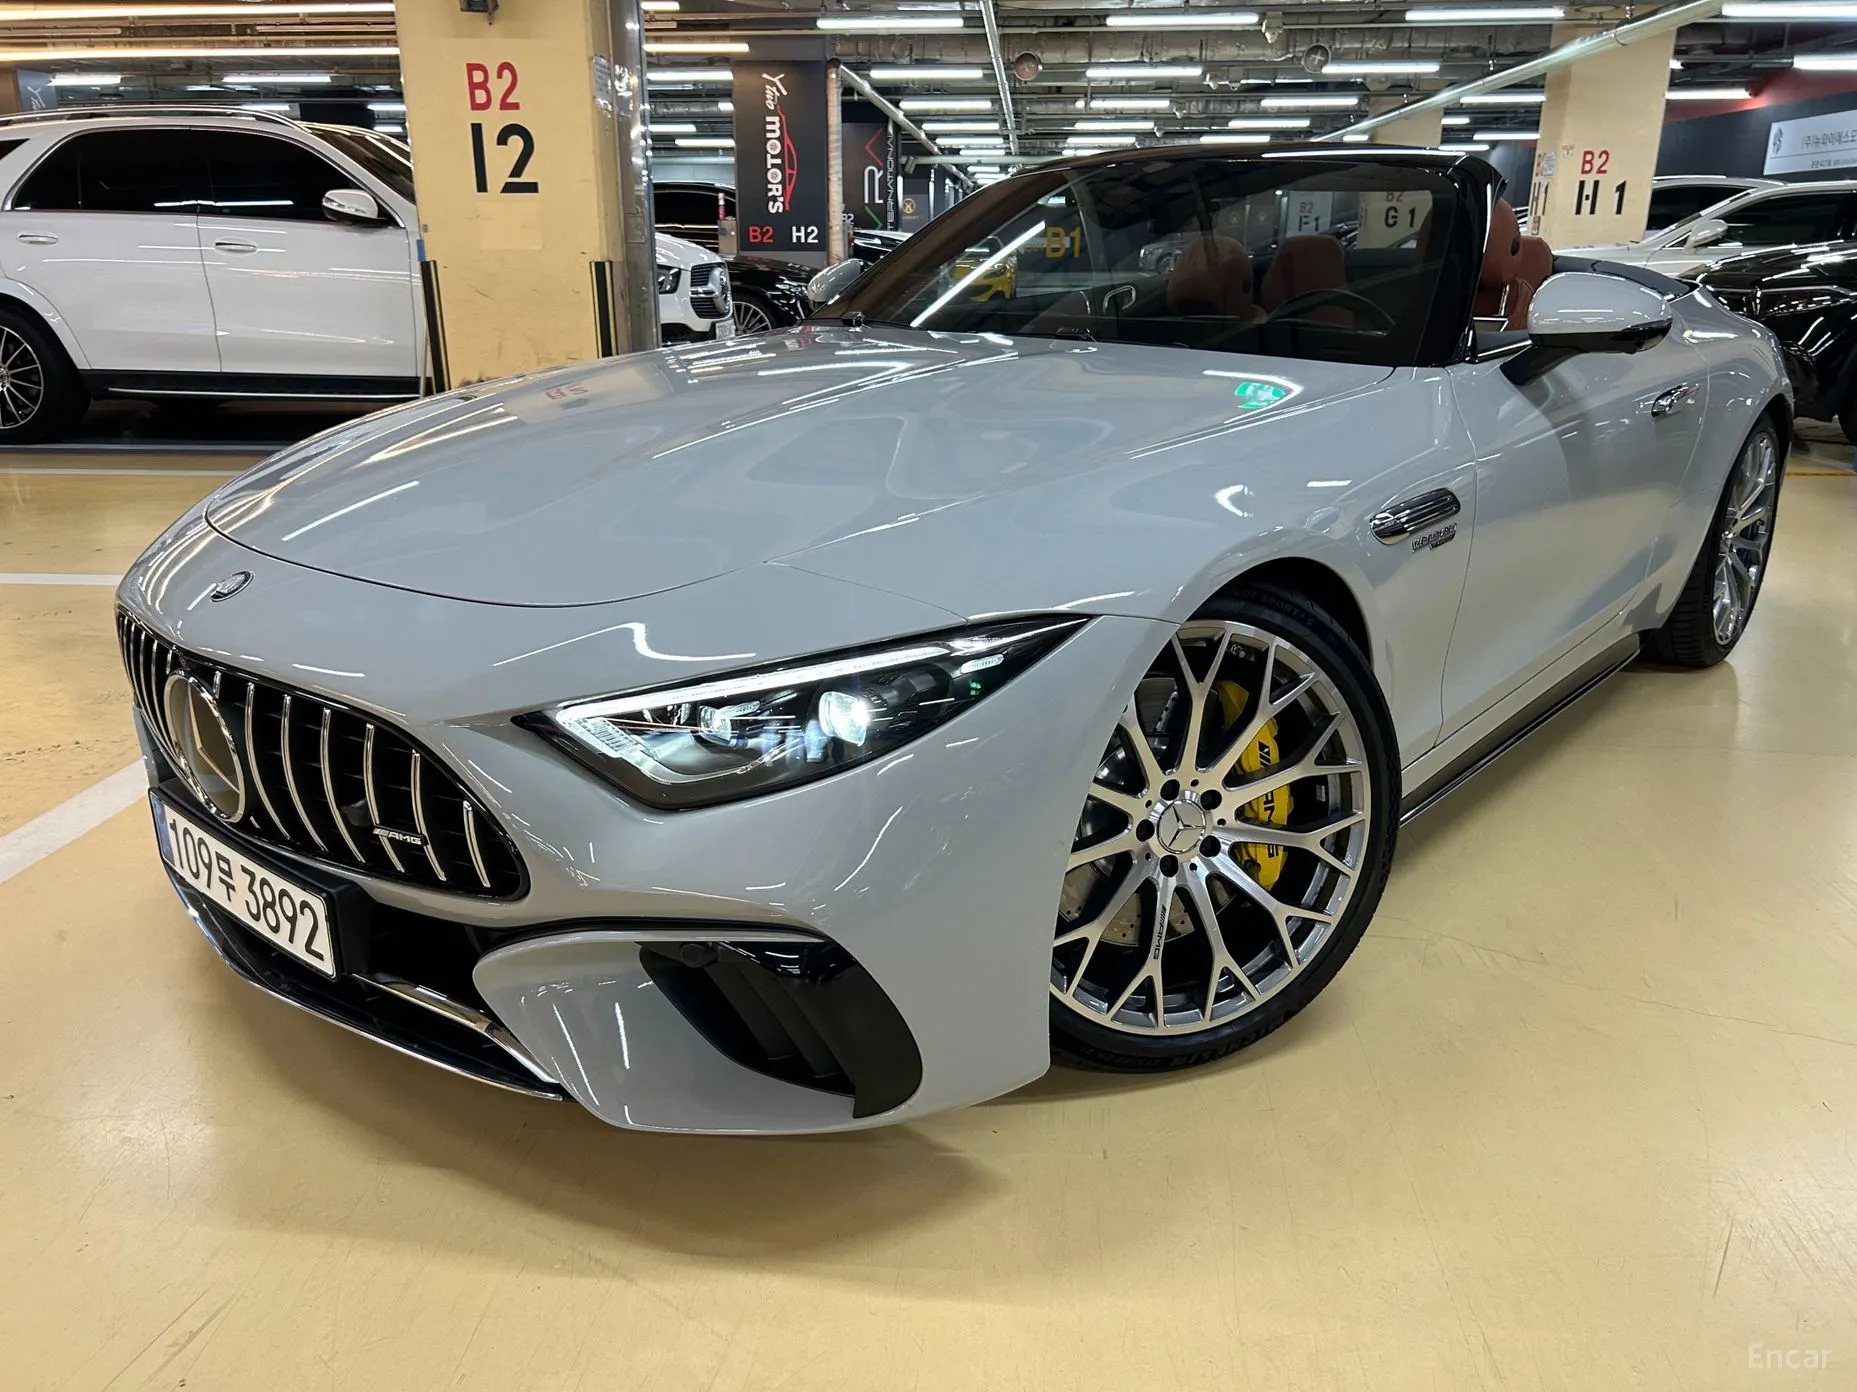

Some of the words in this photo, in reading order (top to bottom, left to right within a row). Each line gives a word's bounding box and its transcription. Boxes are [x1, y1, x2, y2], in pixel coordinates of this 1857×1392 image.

[466, 62, 520, 111] B2
[1580, 150, 1610, 175] B2
[749, 226, 774, 243] B2
[791, 226, 819, 243] H2
[1046, 226, 1081, 258] B1
[386, 830, 422, 845] AMG
[240, 864, 325, 962] 3892
